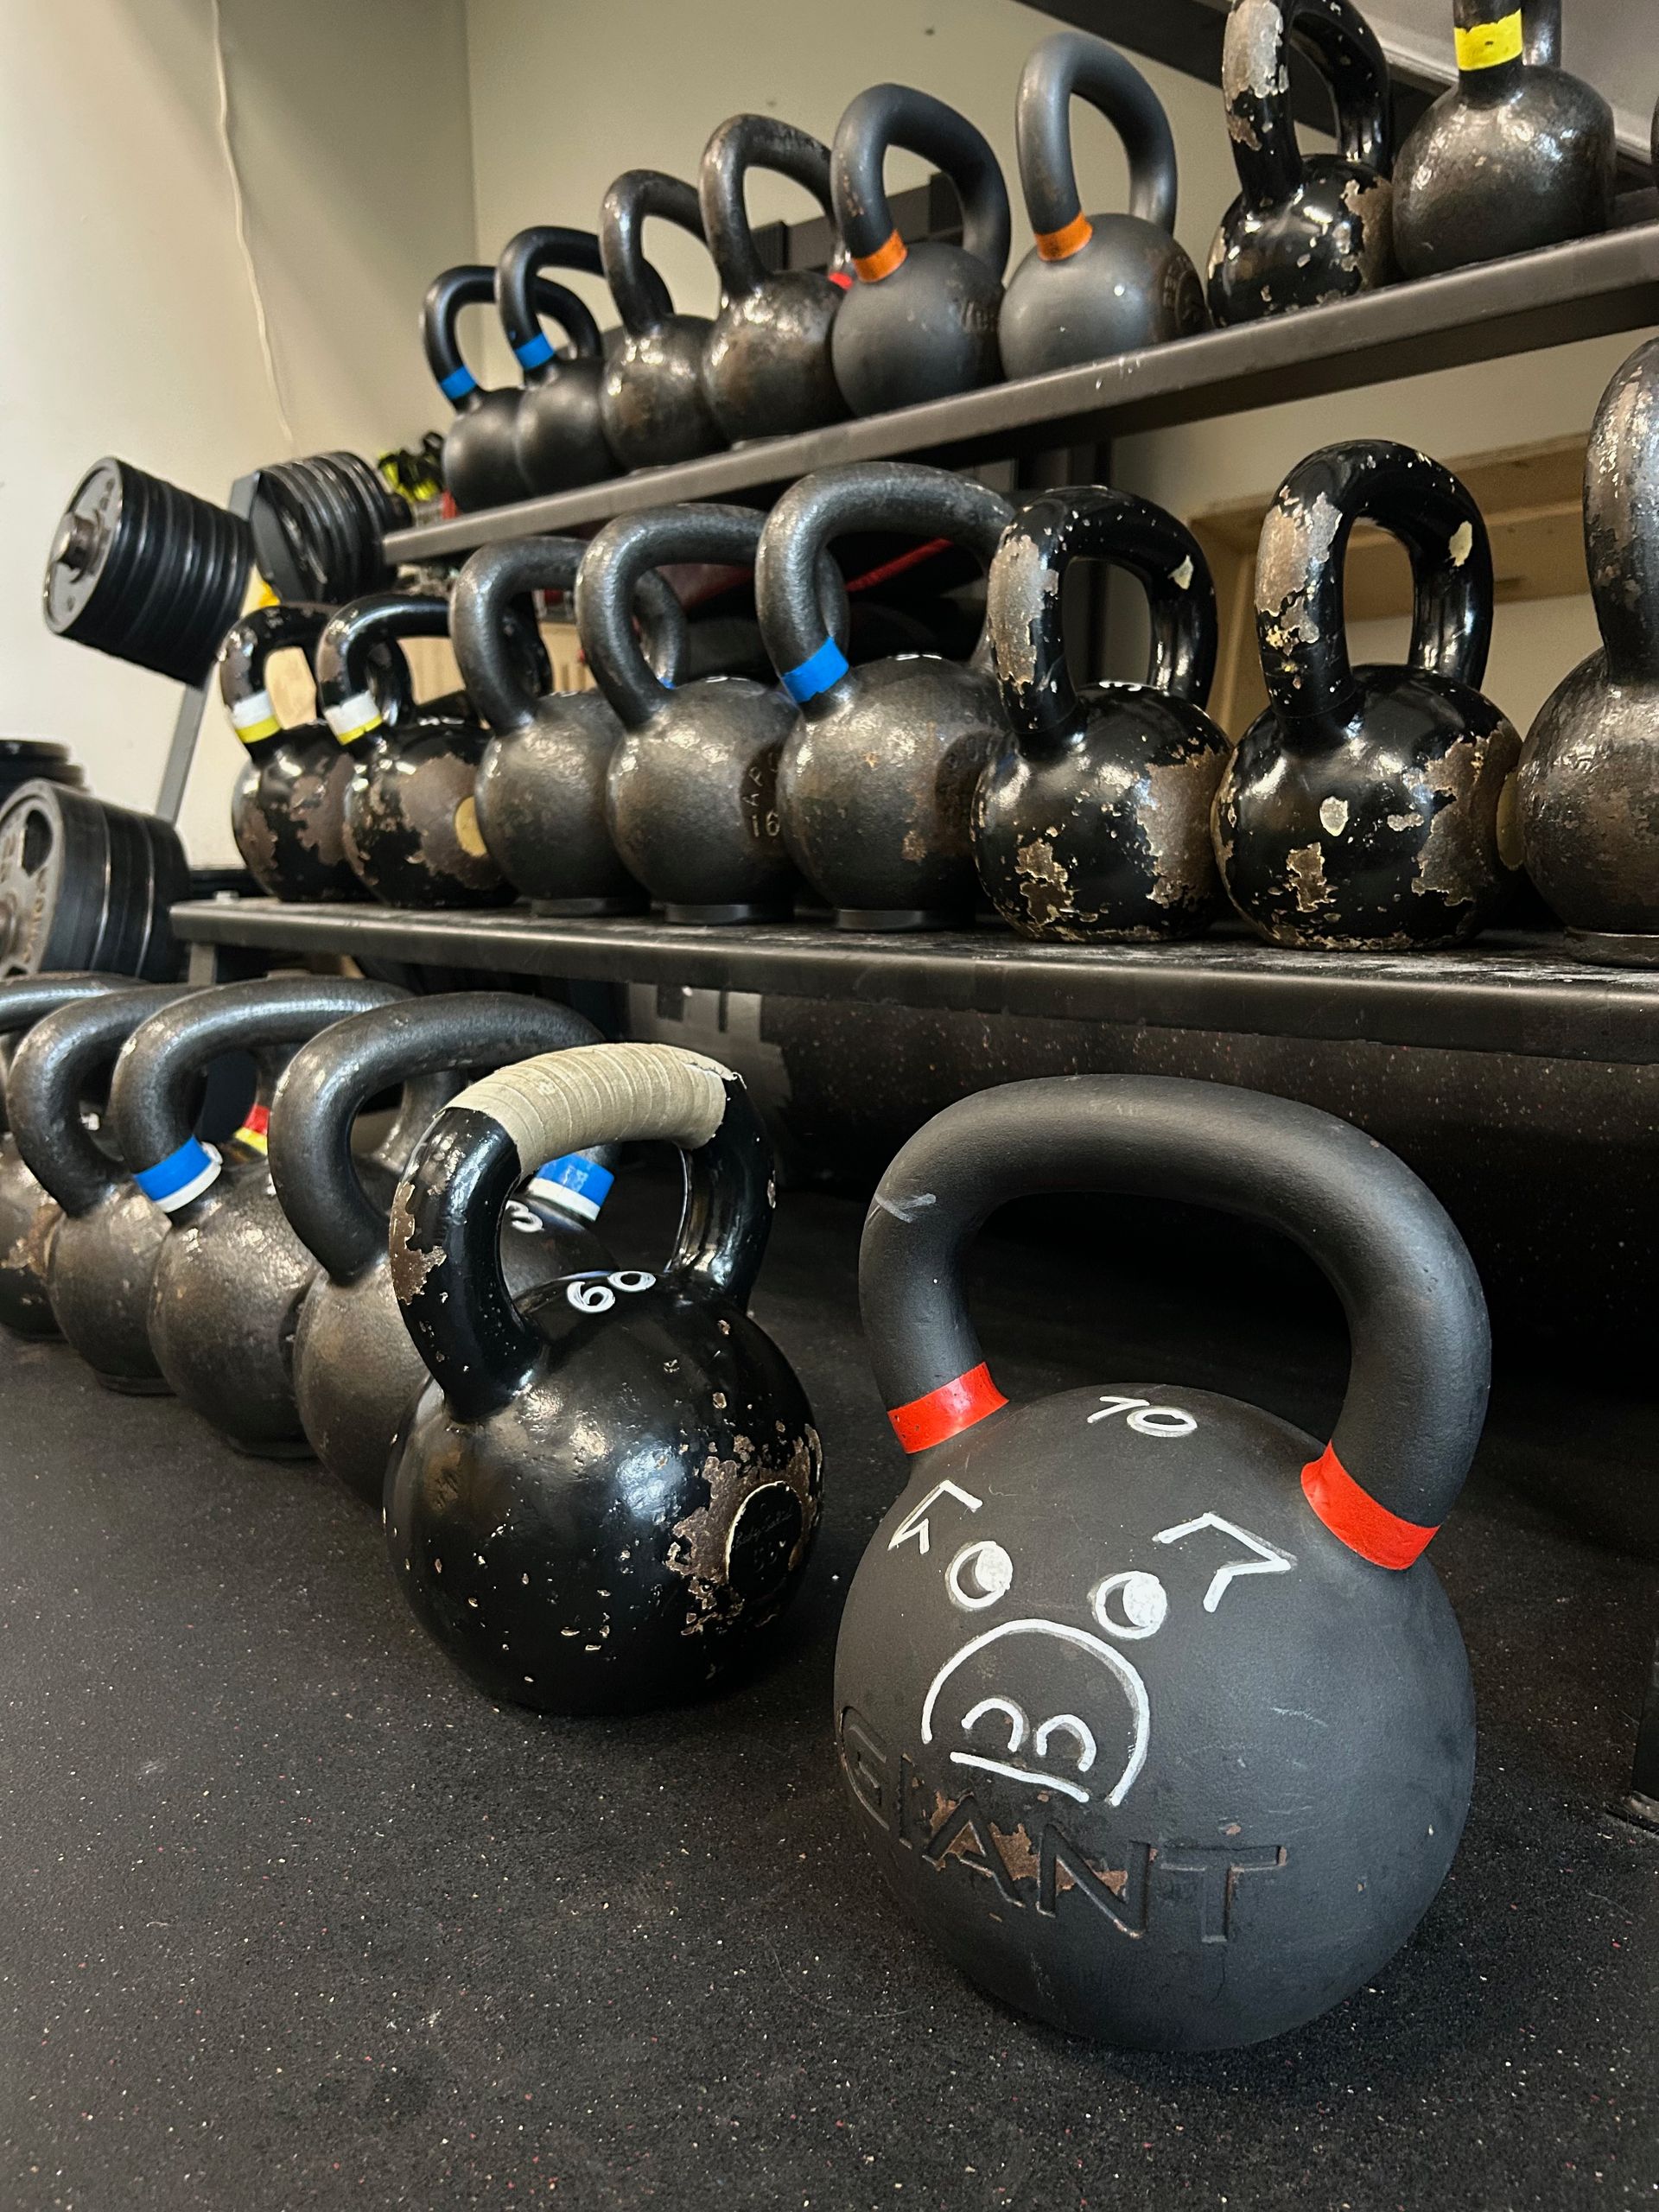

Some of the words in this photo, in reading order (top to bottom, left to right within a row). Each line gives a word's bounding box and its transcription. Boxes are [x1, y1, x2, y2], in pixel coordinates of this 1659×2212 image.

[752, 809, 780, 837] 16
[566, 1270, 657, 1313] 60
[1087, 1395, 1198, 1438] 70
[836, 1705, 1287, 1943] GIANT
